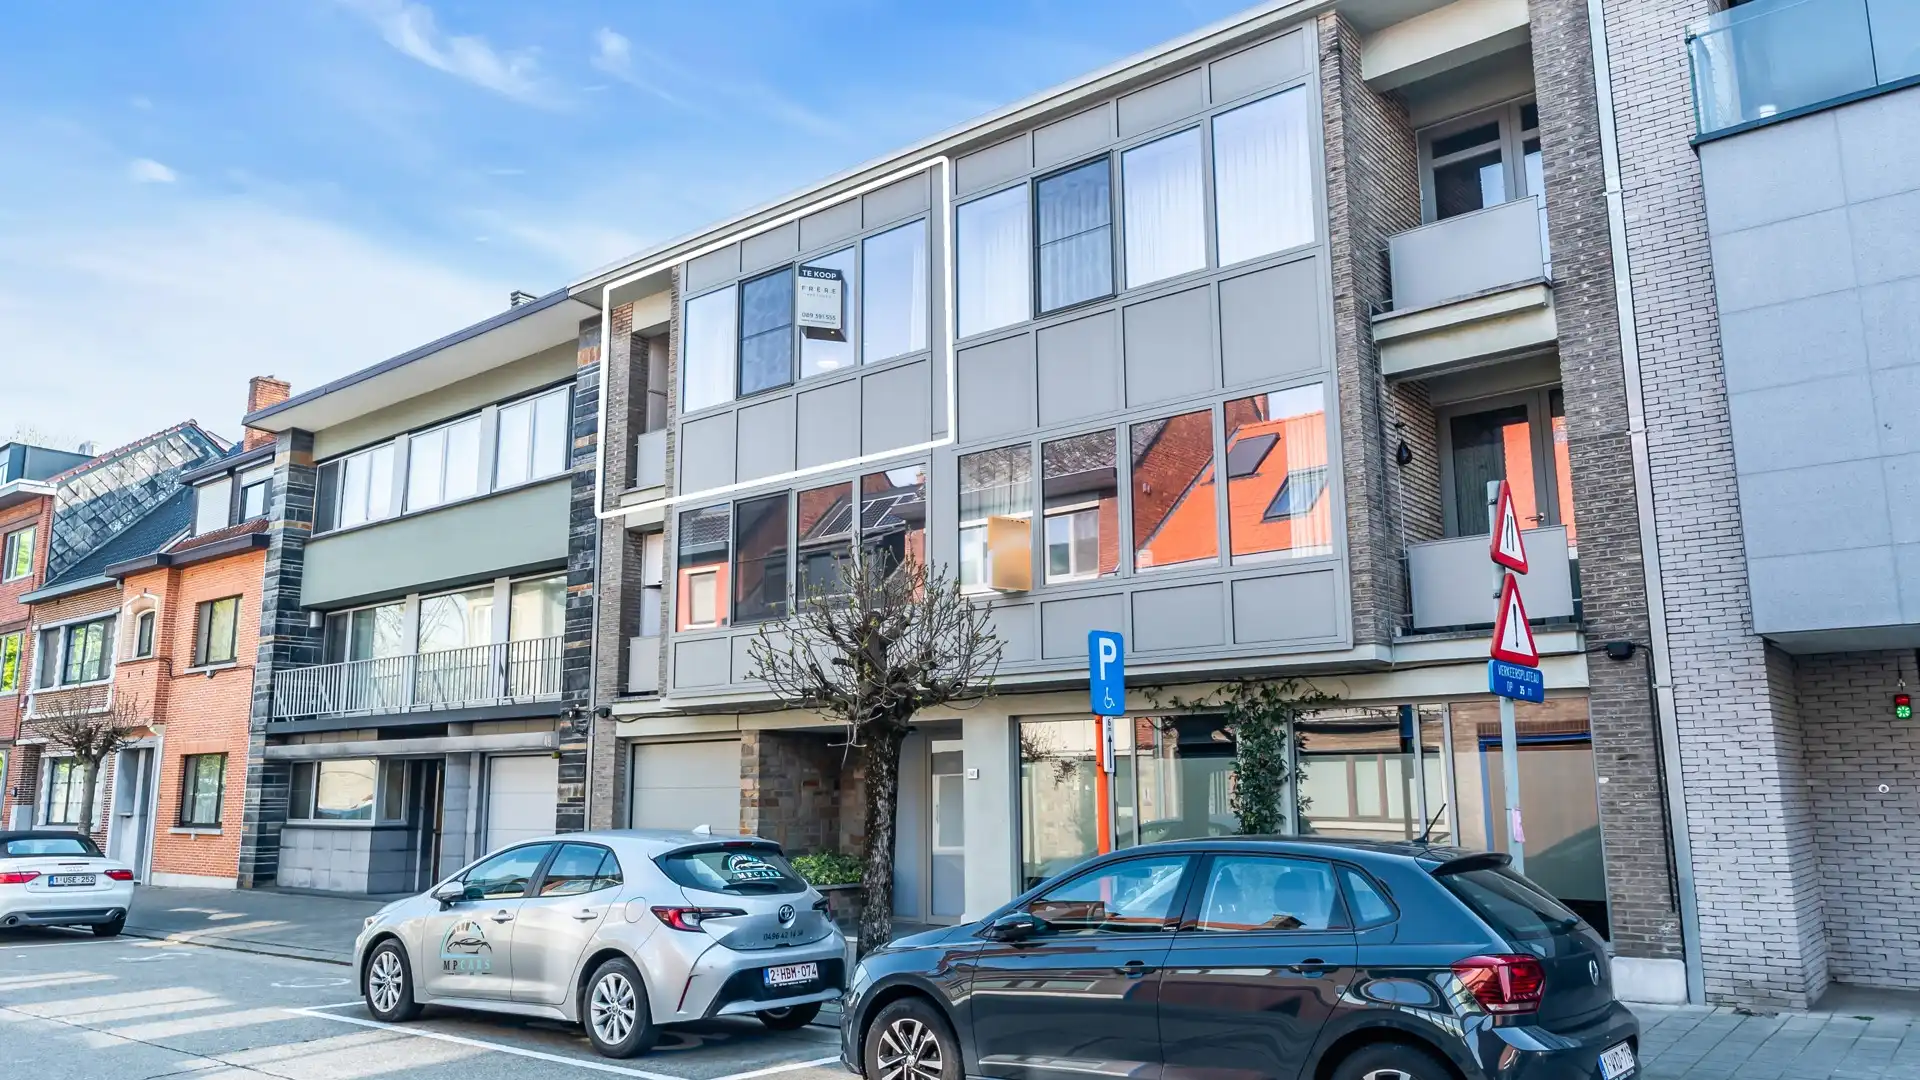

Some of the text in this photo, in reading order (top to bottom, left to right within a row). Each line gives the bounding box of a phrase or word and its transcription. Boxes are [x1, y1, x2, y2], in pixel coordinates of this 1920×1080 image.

[801, 269, 837, 279] TE KOOP
[1098, 637, 1117, 681] P
[1497, 664, 1540, 684] VERKEERSPLATEAU
[770, 963, 817, 981] 2-HBM-074
